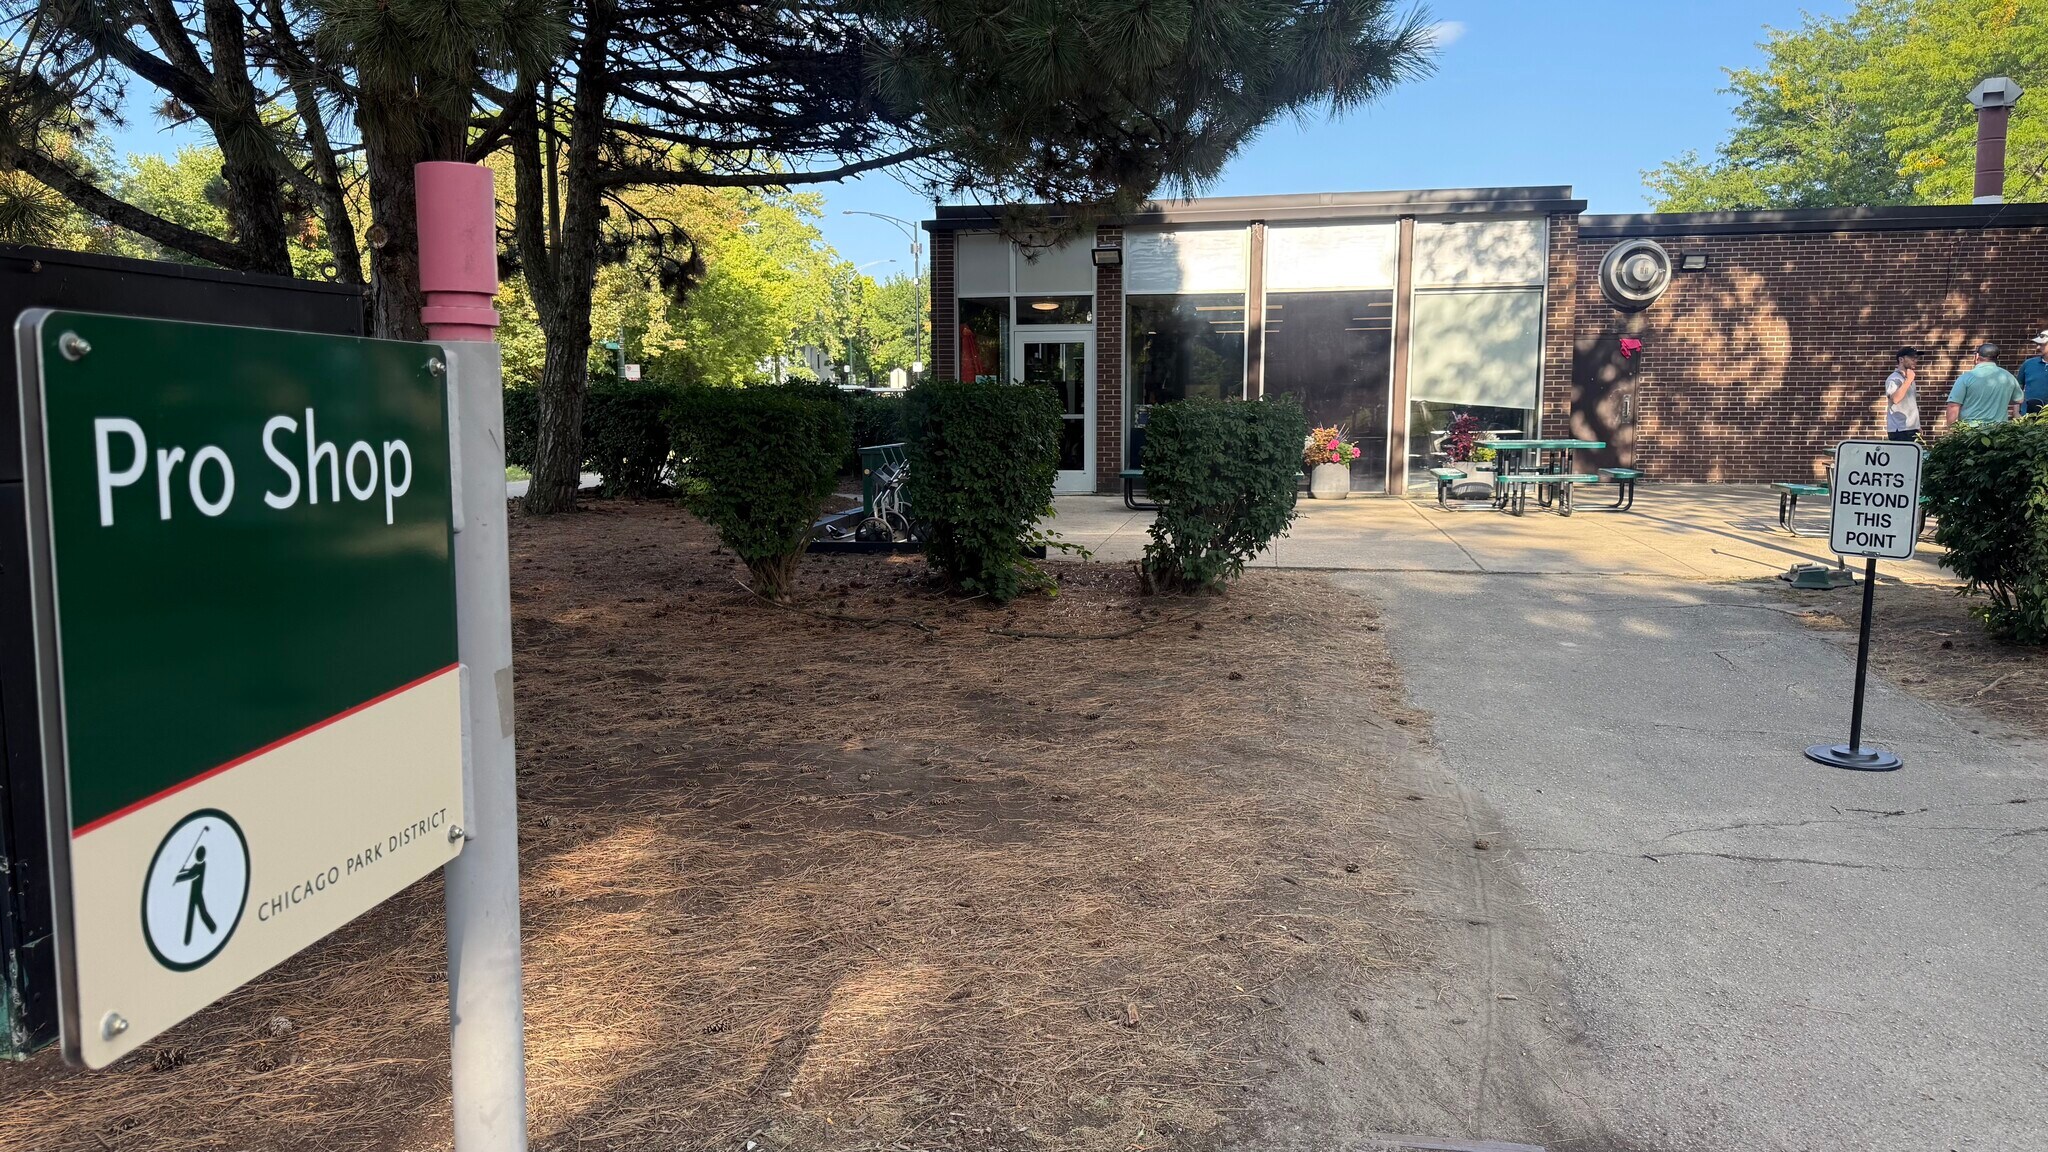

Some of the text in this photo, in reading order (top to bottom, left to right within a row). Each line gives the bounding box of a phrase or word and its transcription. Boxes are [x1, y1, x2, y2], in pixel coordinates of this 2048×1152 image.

[94, 407, 412, 527] Pro Shop
[1865, 451, 1890, 467] NO
[1848, 471, 1904, 488] CARTS
[1840, 491, 1909, 508] BEYOND
[1854, 511, 1892, 528] THIS
[1845, 531, 1896, 548] POINT
[258, 808, 447, 922] CHICAGO PARK DISTRICT
